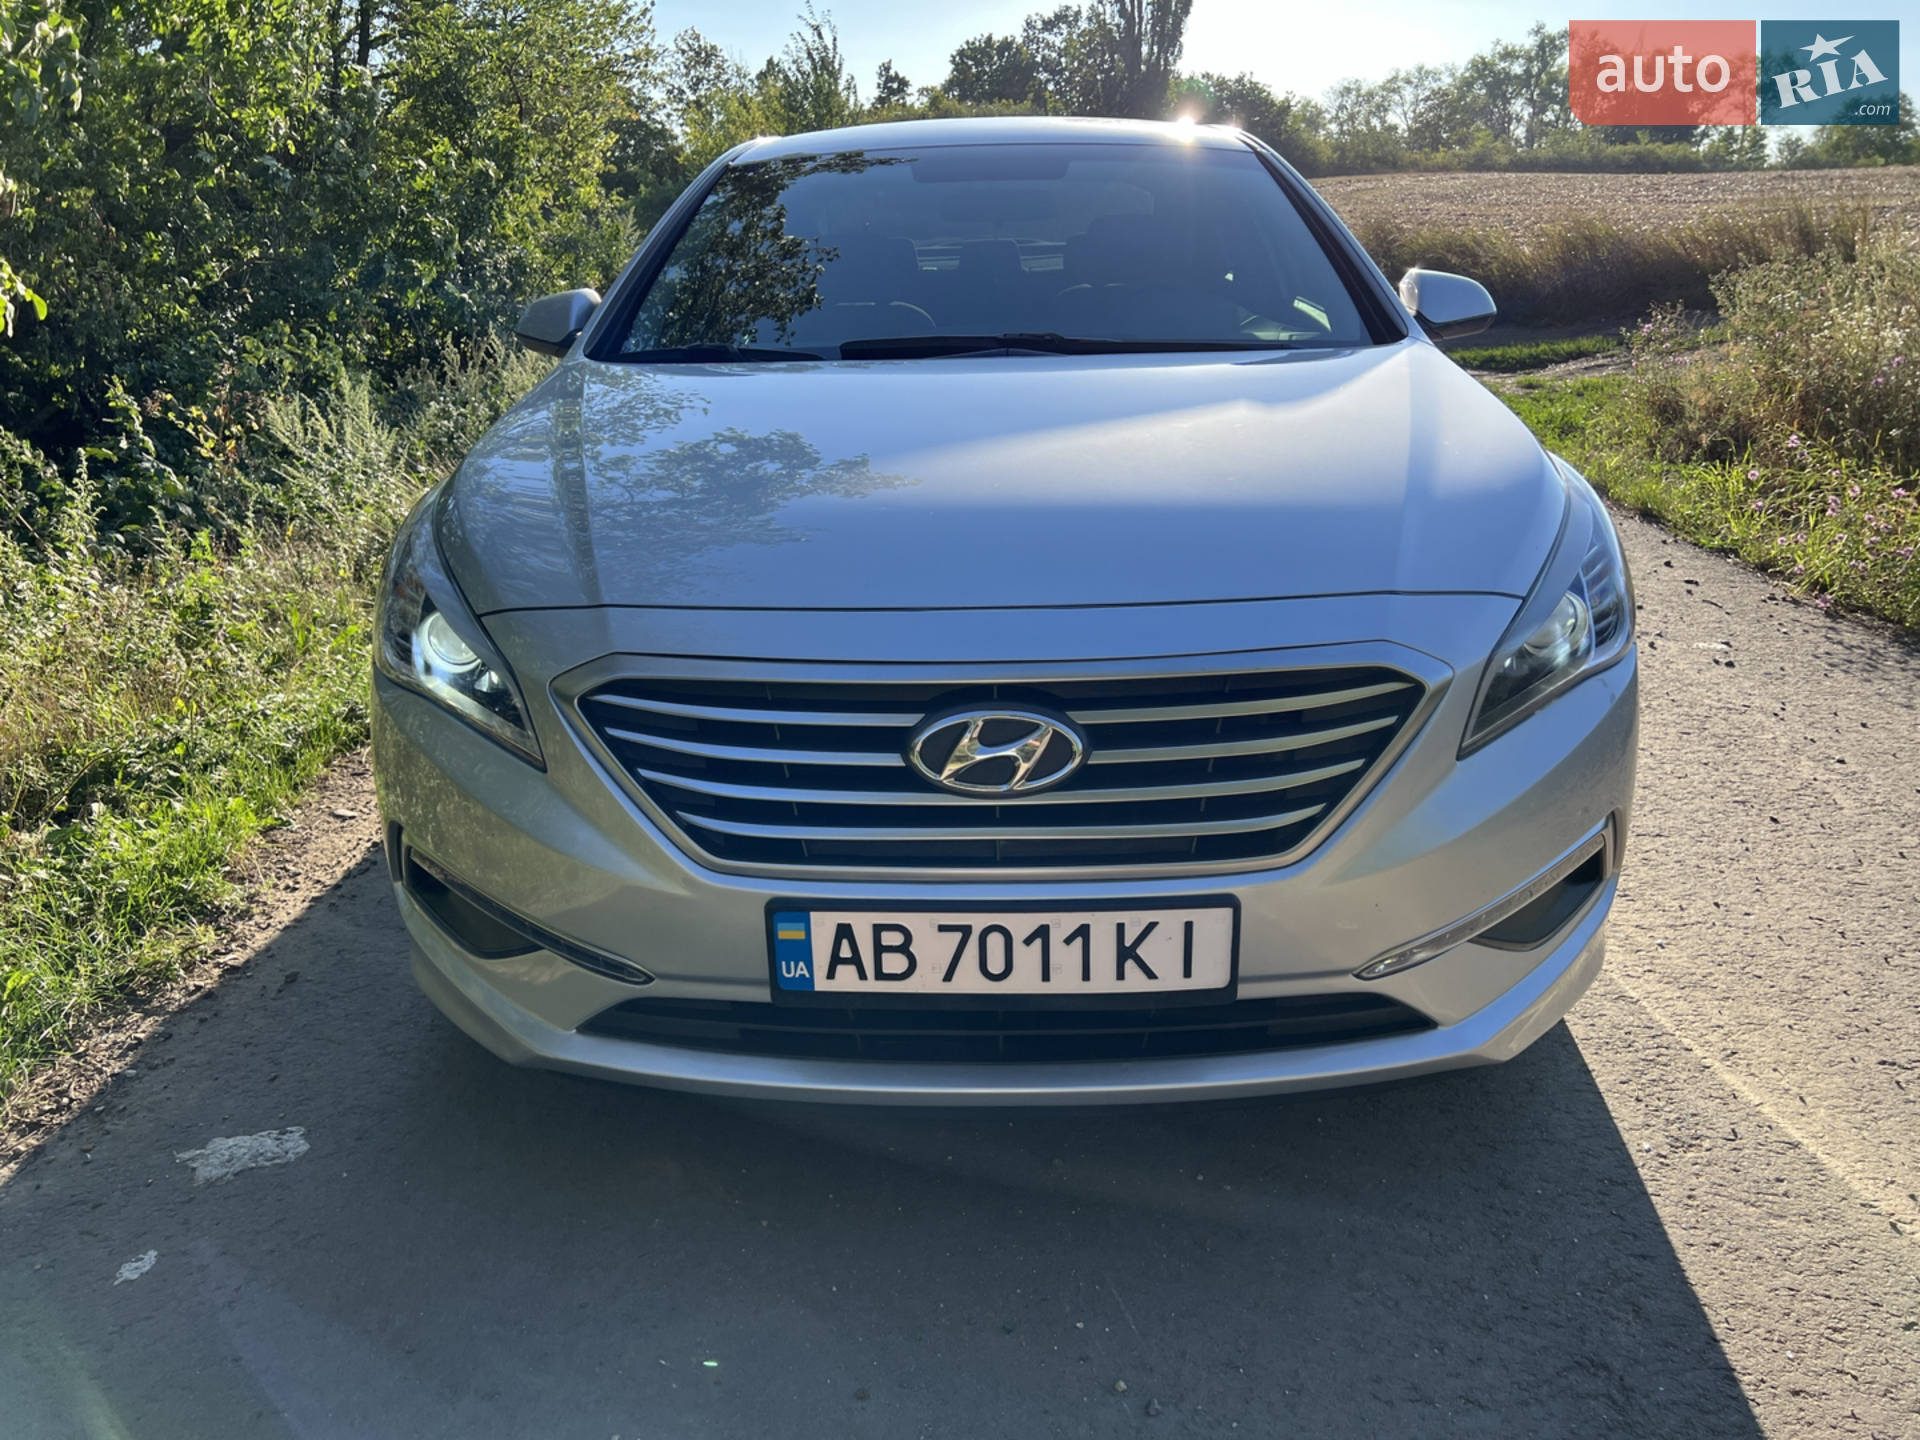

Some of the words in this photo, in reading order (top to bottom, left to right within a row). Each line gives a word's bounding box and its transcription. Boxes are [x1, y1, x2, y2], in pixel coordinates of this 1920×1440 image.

[781, 960, 810, 979] UA
[826, 922, 918, 982] AB
[937, 922, 1091, 983] 7011
[1115, 920, 1194, 982] KI
